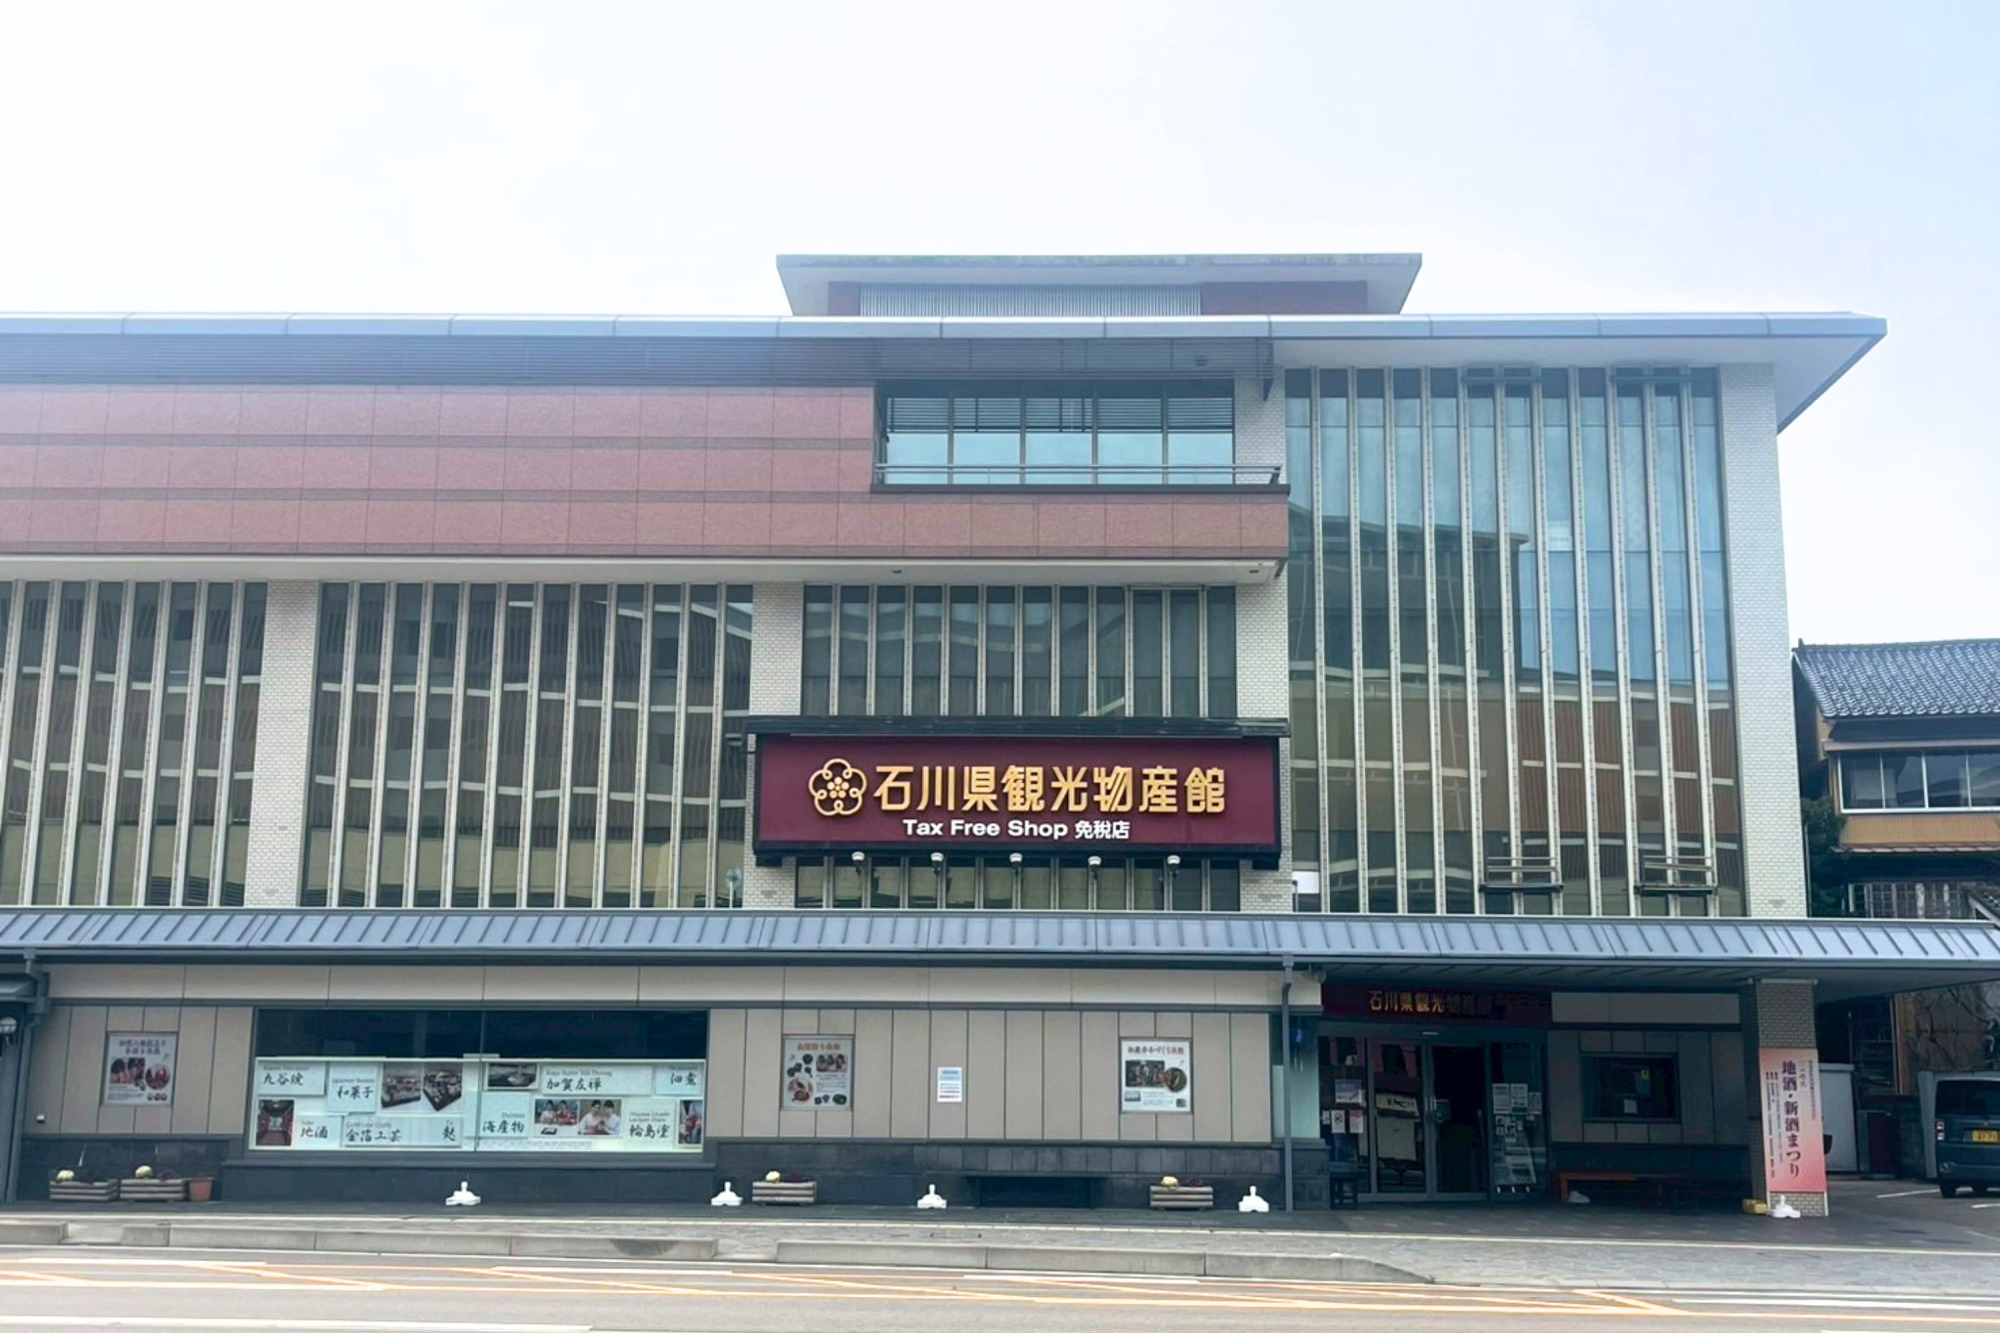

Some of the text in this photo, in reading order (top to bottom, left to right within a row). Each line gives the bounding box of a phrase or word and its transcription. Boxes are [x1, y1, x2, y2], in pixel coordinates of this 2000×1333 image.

[873, 764, 1226, 814] 石川県観光物産館
[903, 819, 1130, 840] Tax Free Shop 免税店
[263, 1072, 304, 1087] 九谷焼
[337, 1085, 374, 1099] 和菓子
[482, 1120, 525, 1133] 海産物
[1782, 1060, 1801, 1178] 地酒・新酒まつり
[300, 1126, 328, 1139] 地酒
[346, 1129, 402, 1142] 金箔工芸
[629, 1123, 670, 1139] 輪島塗
